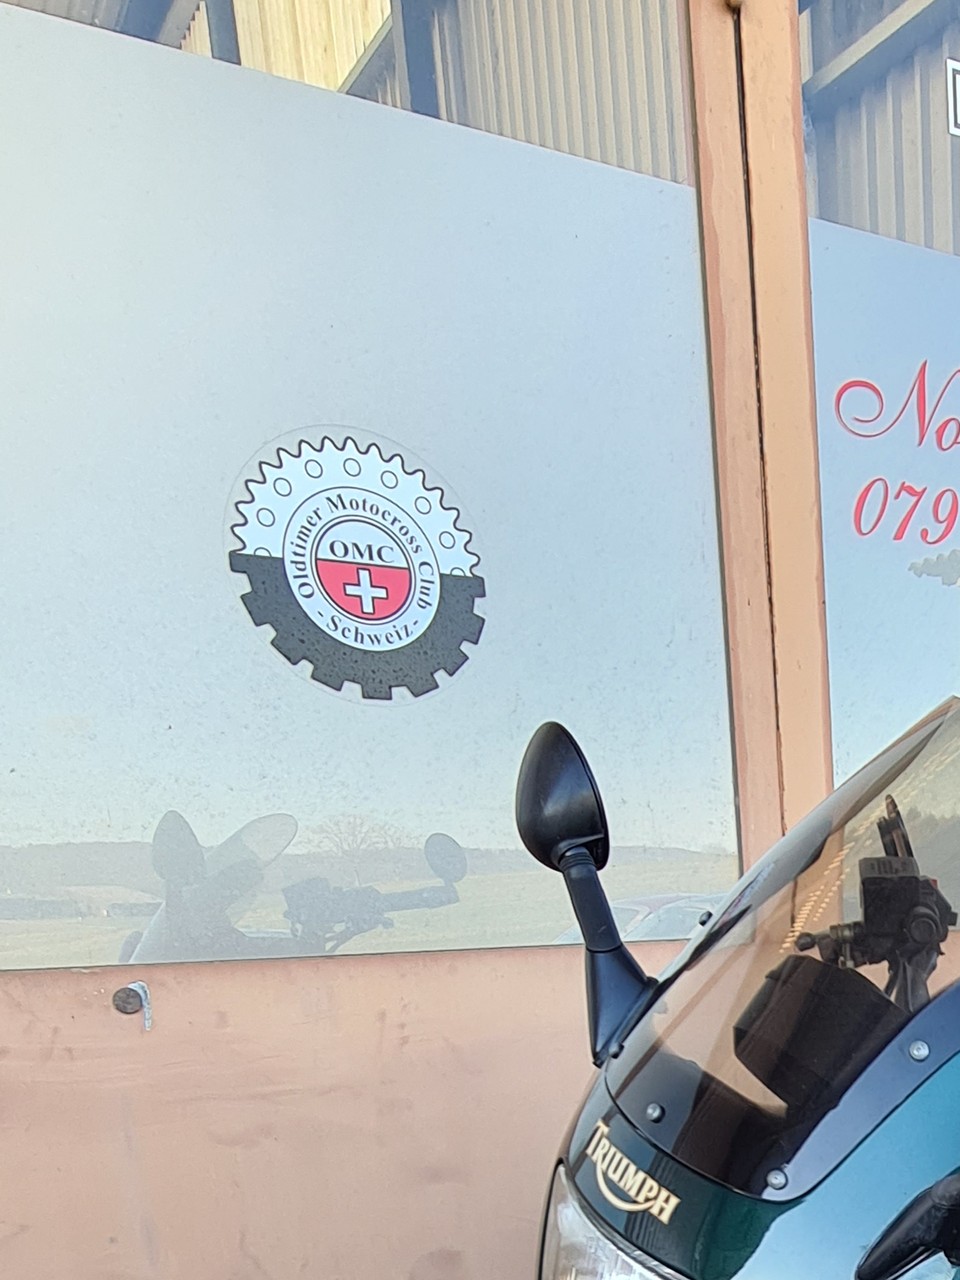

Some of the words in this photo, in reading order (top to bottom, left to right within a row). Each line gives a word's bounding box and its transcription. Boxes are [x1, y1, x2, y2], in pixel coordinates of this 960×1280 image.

[291, 507, 323, 599] Oldtimer
[325, 493, 423, 554] Motocross
[418, 561, 435, 610] Club
[329, 540, 394, 563] OMC
[853, 477, 959, 545] 079
[585, 1119, 681, 1225] TRIUMPH
